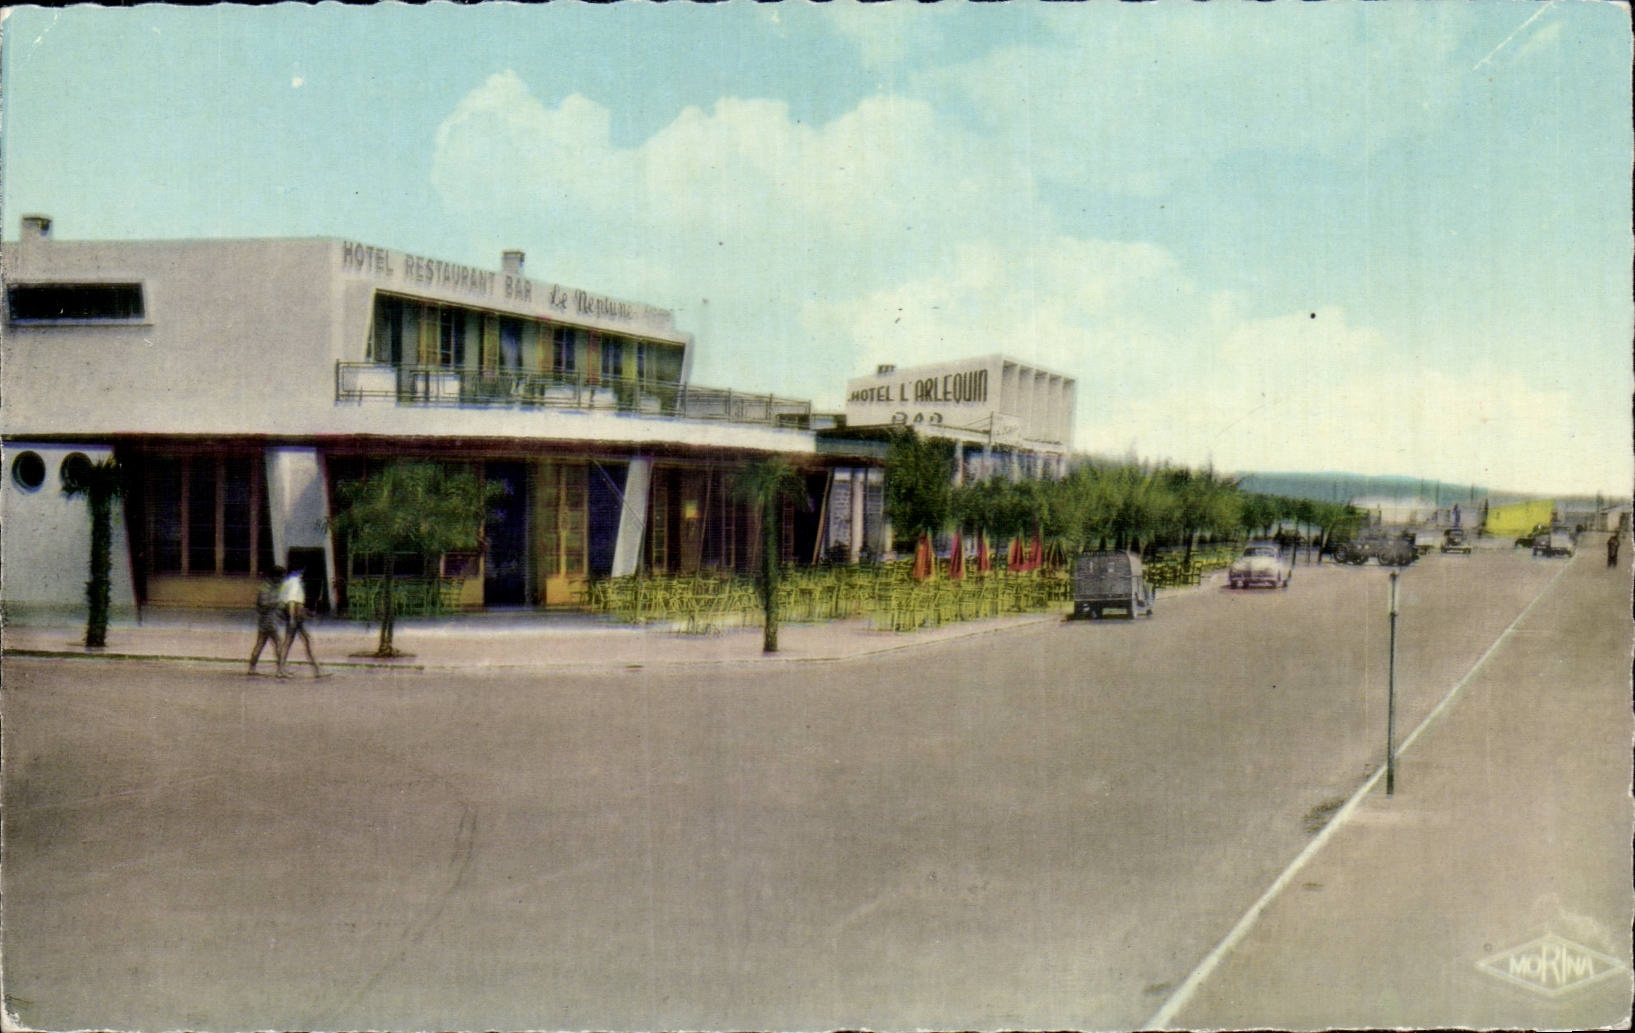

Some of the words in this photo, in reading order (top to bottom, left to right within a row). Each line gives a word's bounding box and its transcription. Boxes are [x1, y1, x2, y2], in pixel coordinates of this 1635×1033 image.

[342, 240, 394, 276] HOTEL
[404, 253, 496, 298] RESTAURANT
[504, 275, 533, 303] BAR
[847, 384, 894, 402] HOTEL
